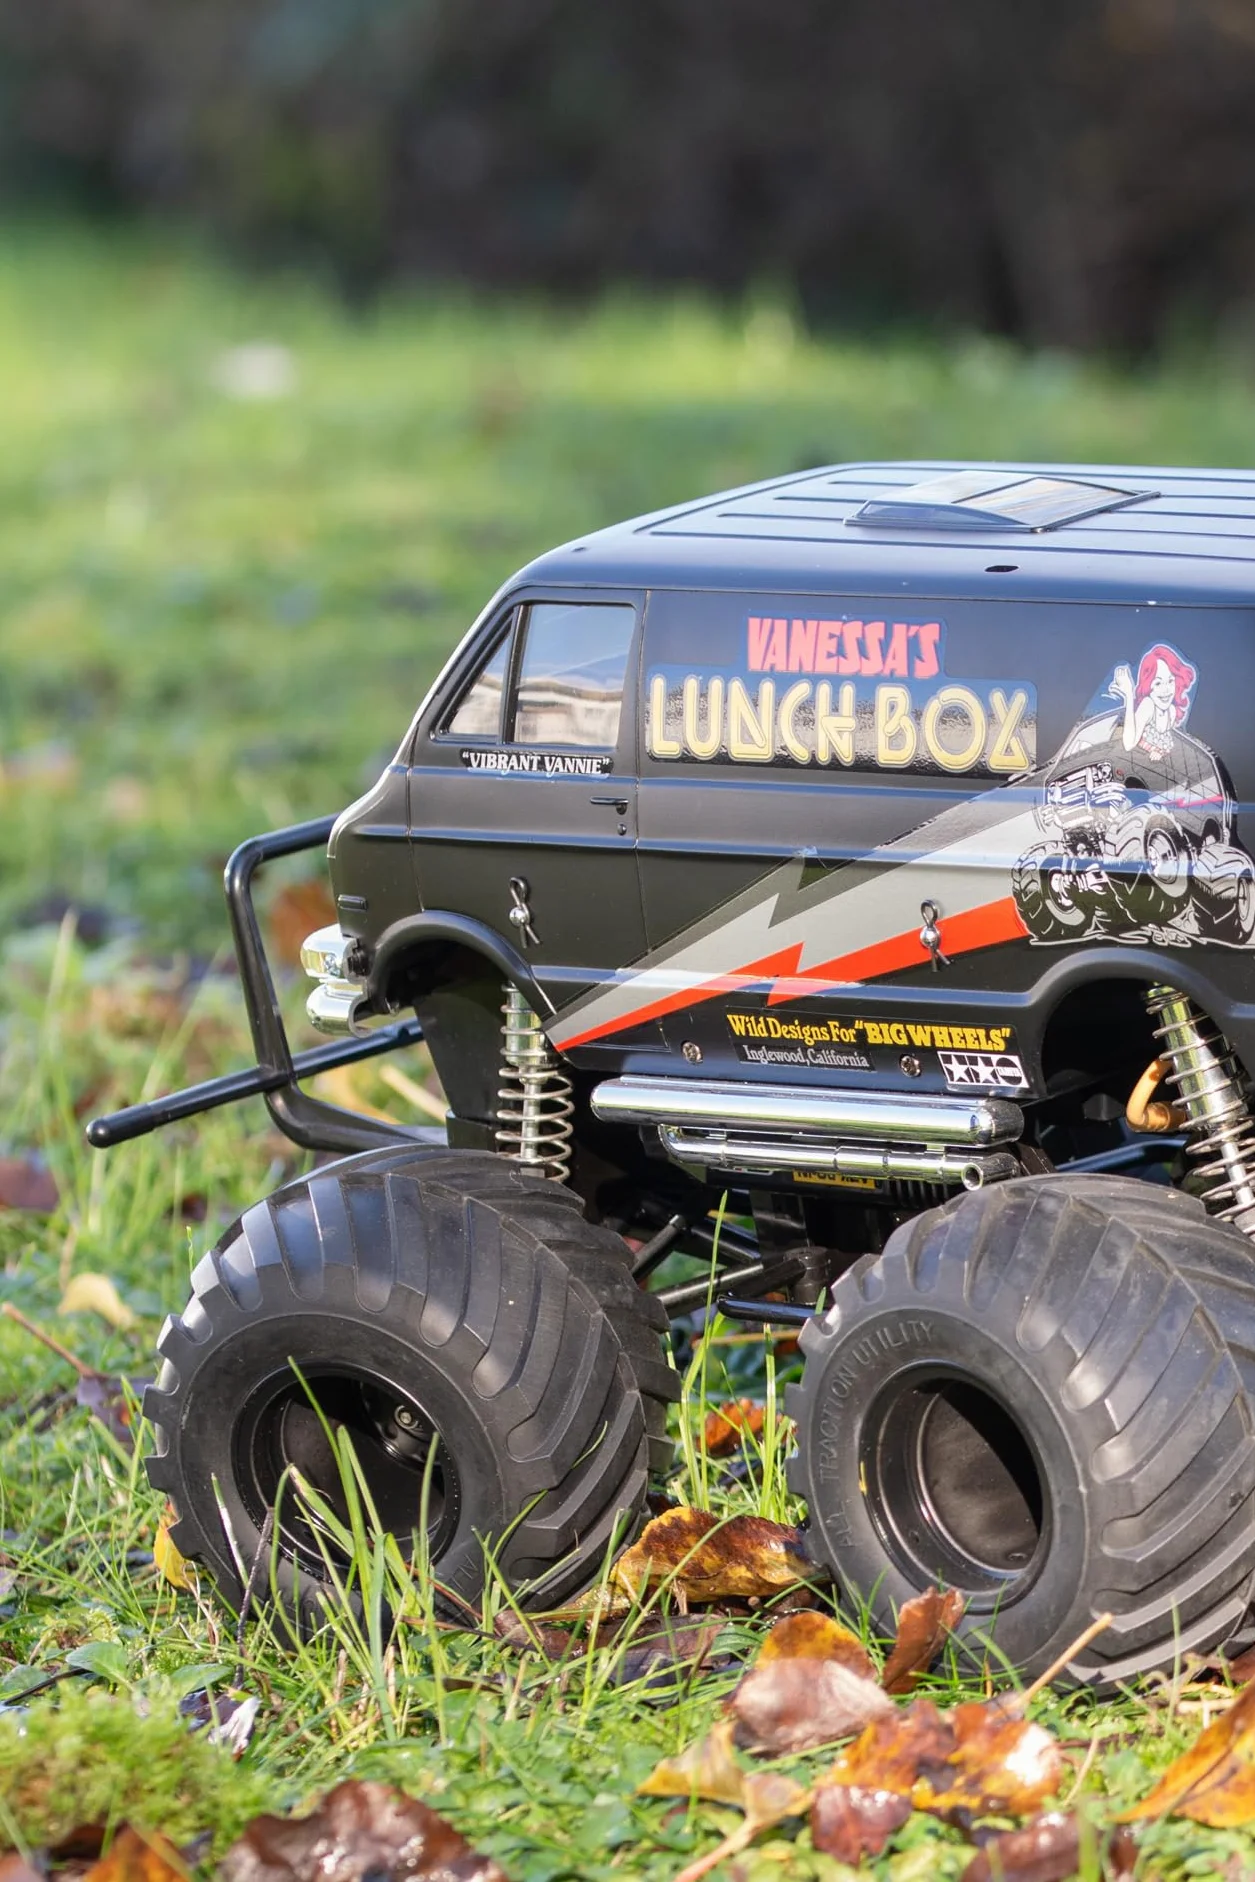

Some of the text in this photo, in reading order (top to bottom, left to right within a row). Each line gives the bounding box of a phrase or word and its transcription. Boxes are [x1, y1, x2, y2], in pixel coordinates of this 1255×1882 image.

[748, 617, 940, 679] VANESSA'S
[648, 673, 1032, 775] LUNCH BOX
[726, 1014, 765, 1038] Wild
[766, 1017, 830, 1046] Designs
[827, 1020, 857, 1043] For
[742, 1045, 870, 1068] Inglewood, California
[819, 1362, 857, 1486] TRACTION
[850, 1319, 934, 1367] UTILITY
